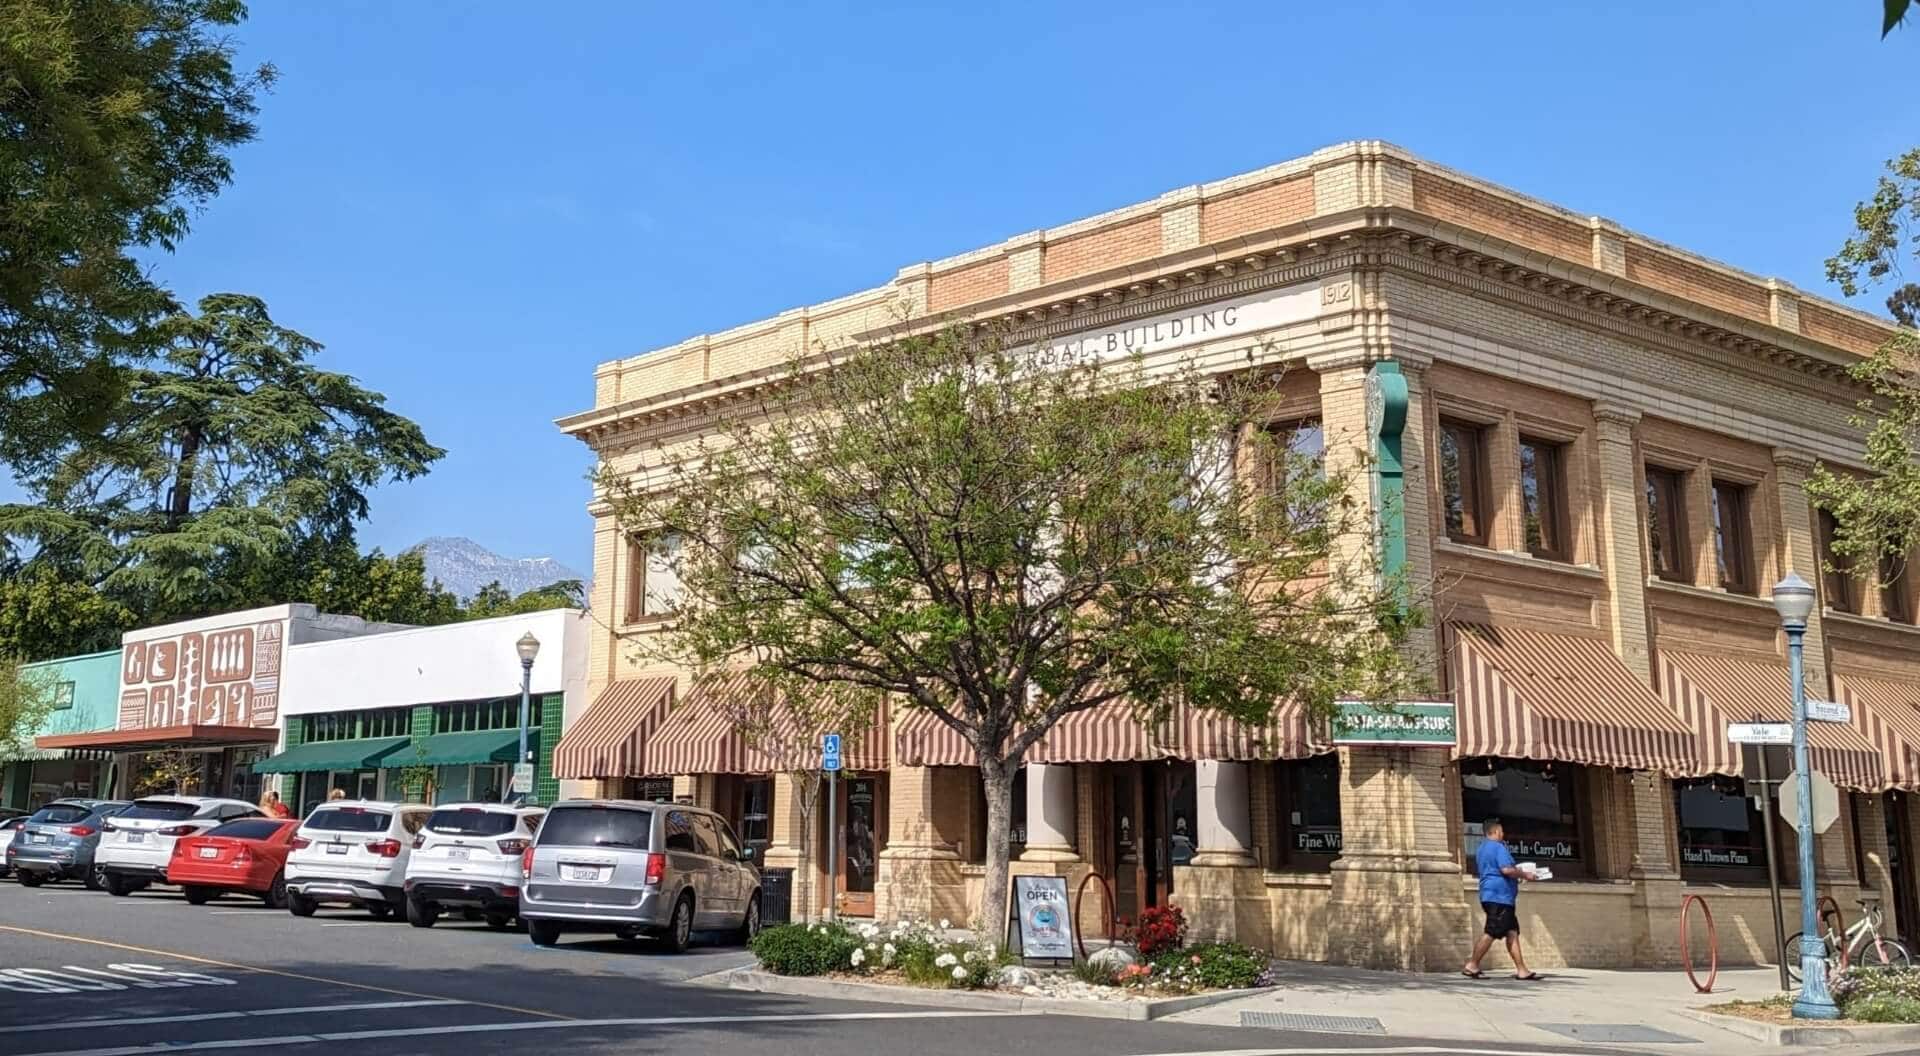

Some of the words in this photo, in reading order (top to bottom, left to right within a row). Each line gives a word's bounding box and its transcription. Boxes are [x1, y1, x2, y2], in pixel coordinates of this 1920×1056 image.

[1320, 283, 1351, 306] 1912
[1106, 306, 1238, 353] BUILDING
[1298, 833, 1323, 848] Fine
[1324, 833, 1341, 849] Wi
[1534, 841, 1556, 858] Carry
[1557, 842, 1572, 857] Out
[1683, 848, 1703, 861] Hand
[1729, 850, 1749, 864] Pizza
[1026, 890, 1058, 901] OPEN
